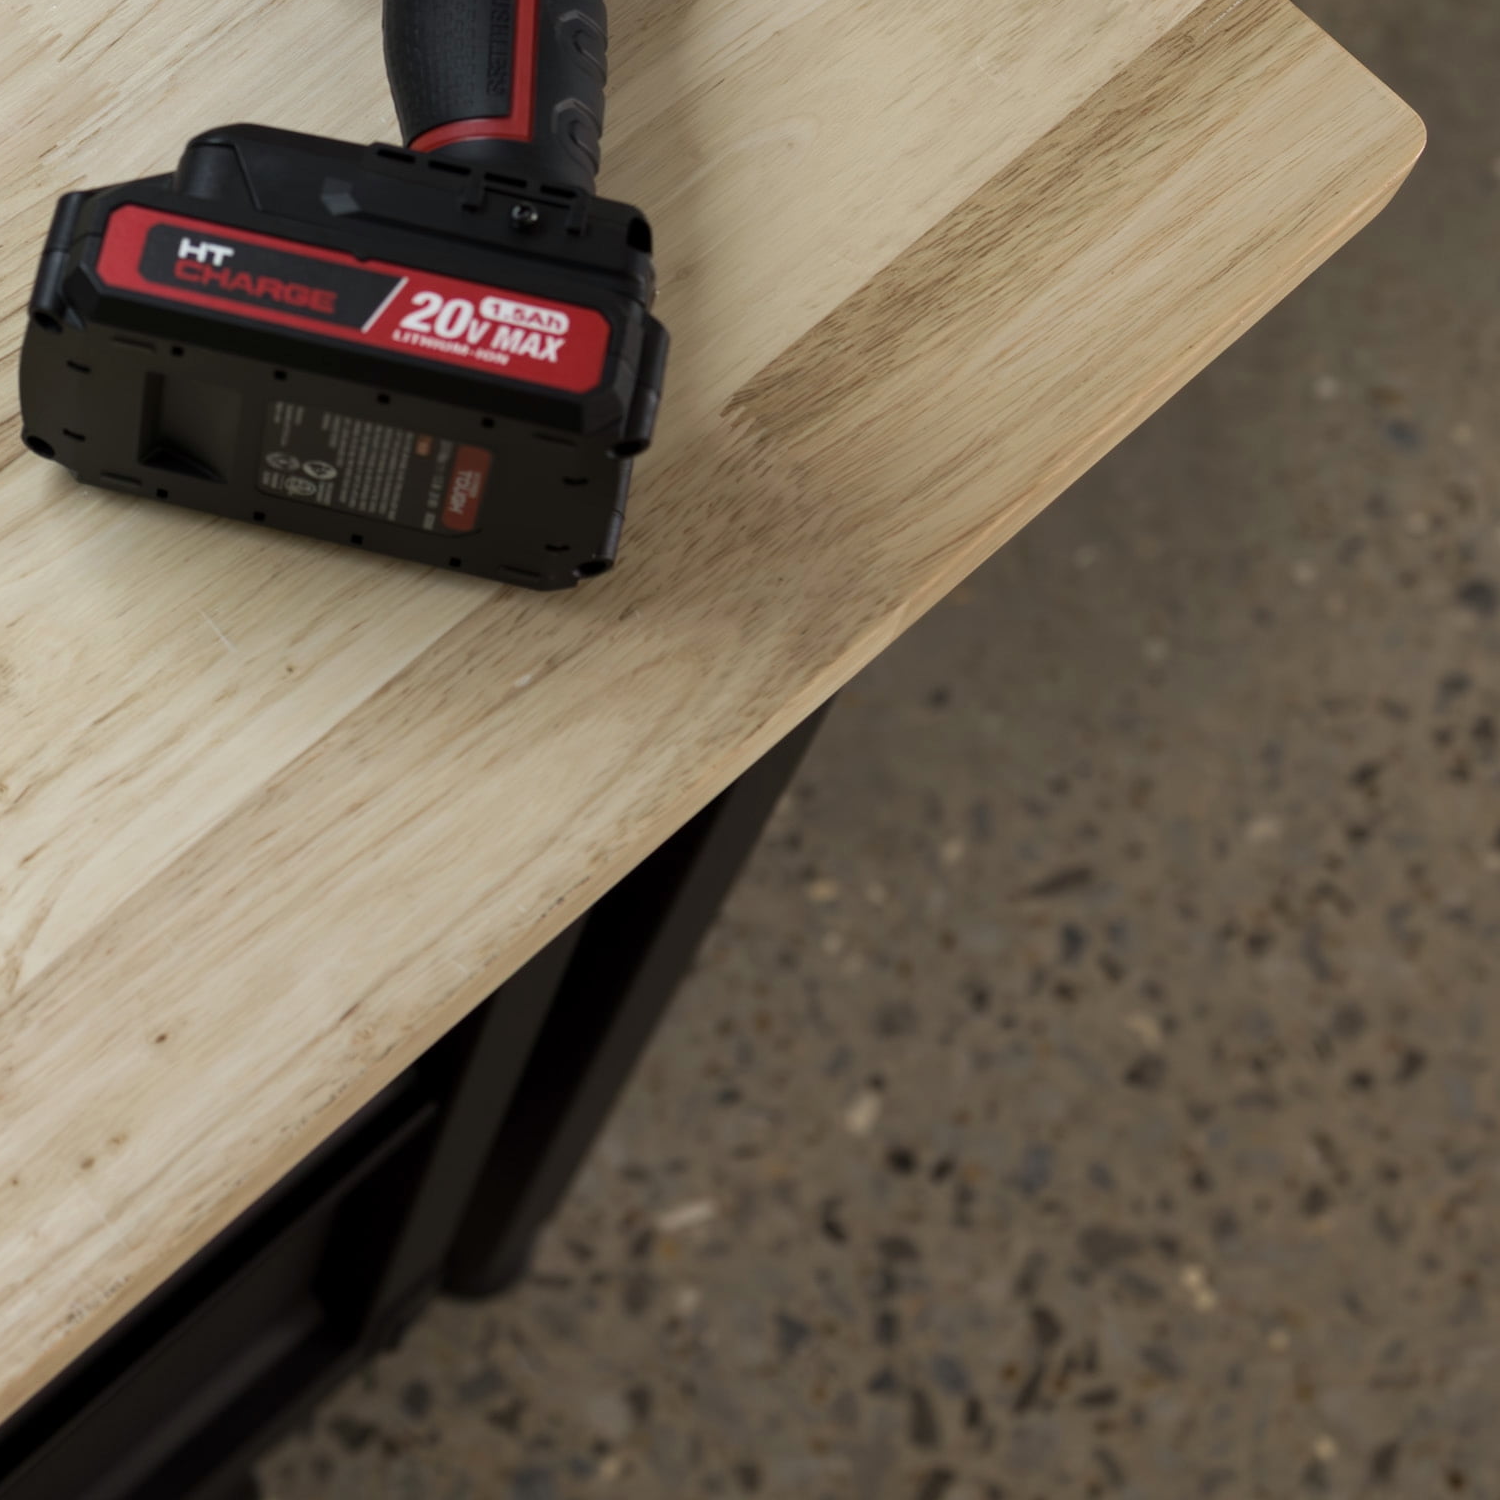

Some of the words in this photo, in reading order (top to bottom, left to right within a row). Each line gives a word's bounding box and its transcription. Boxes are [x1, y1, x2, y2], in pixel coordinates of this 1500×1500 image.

[177, 236, 235, 267] HT
[173, 258, 338, 315] CHARGE
[489, 301, 563, 331] 1.5Ah
[490, 325, 567, 363] MAX
